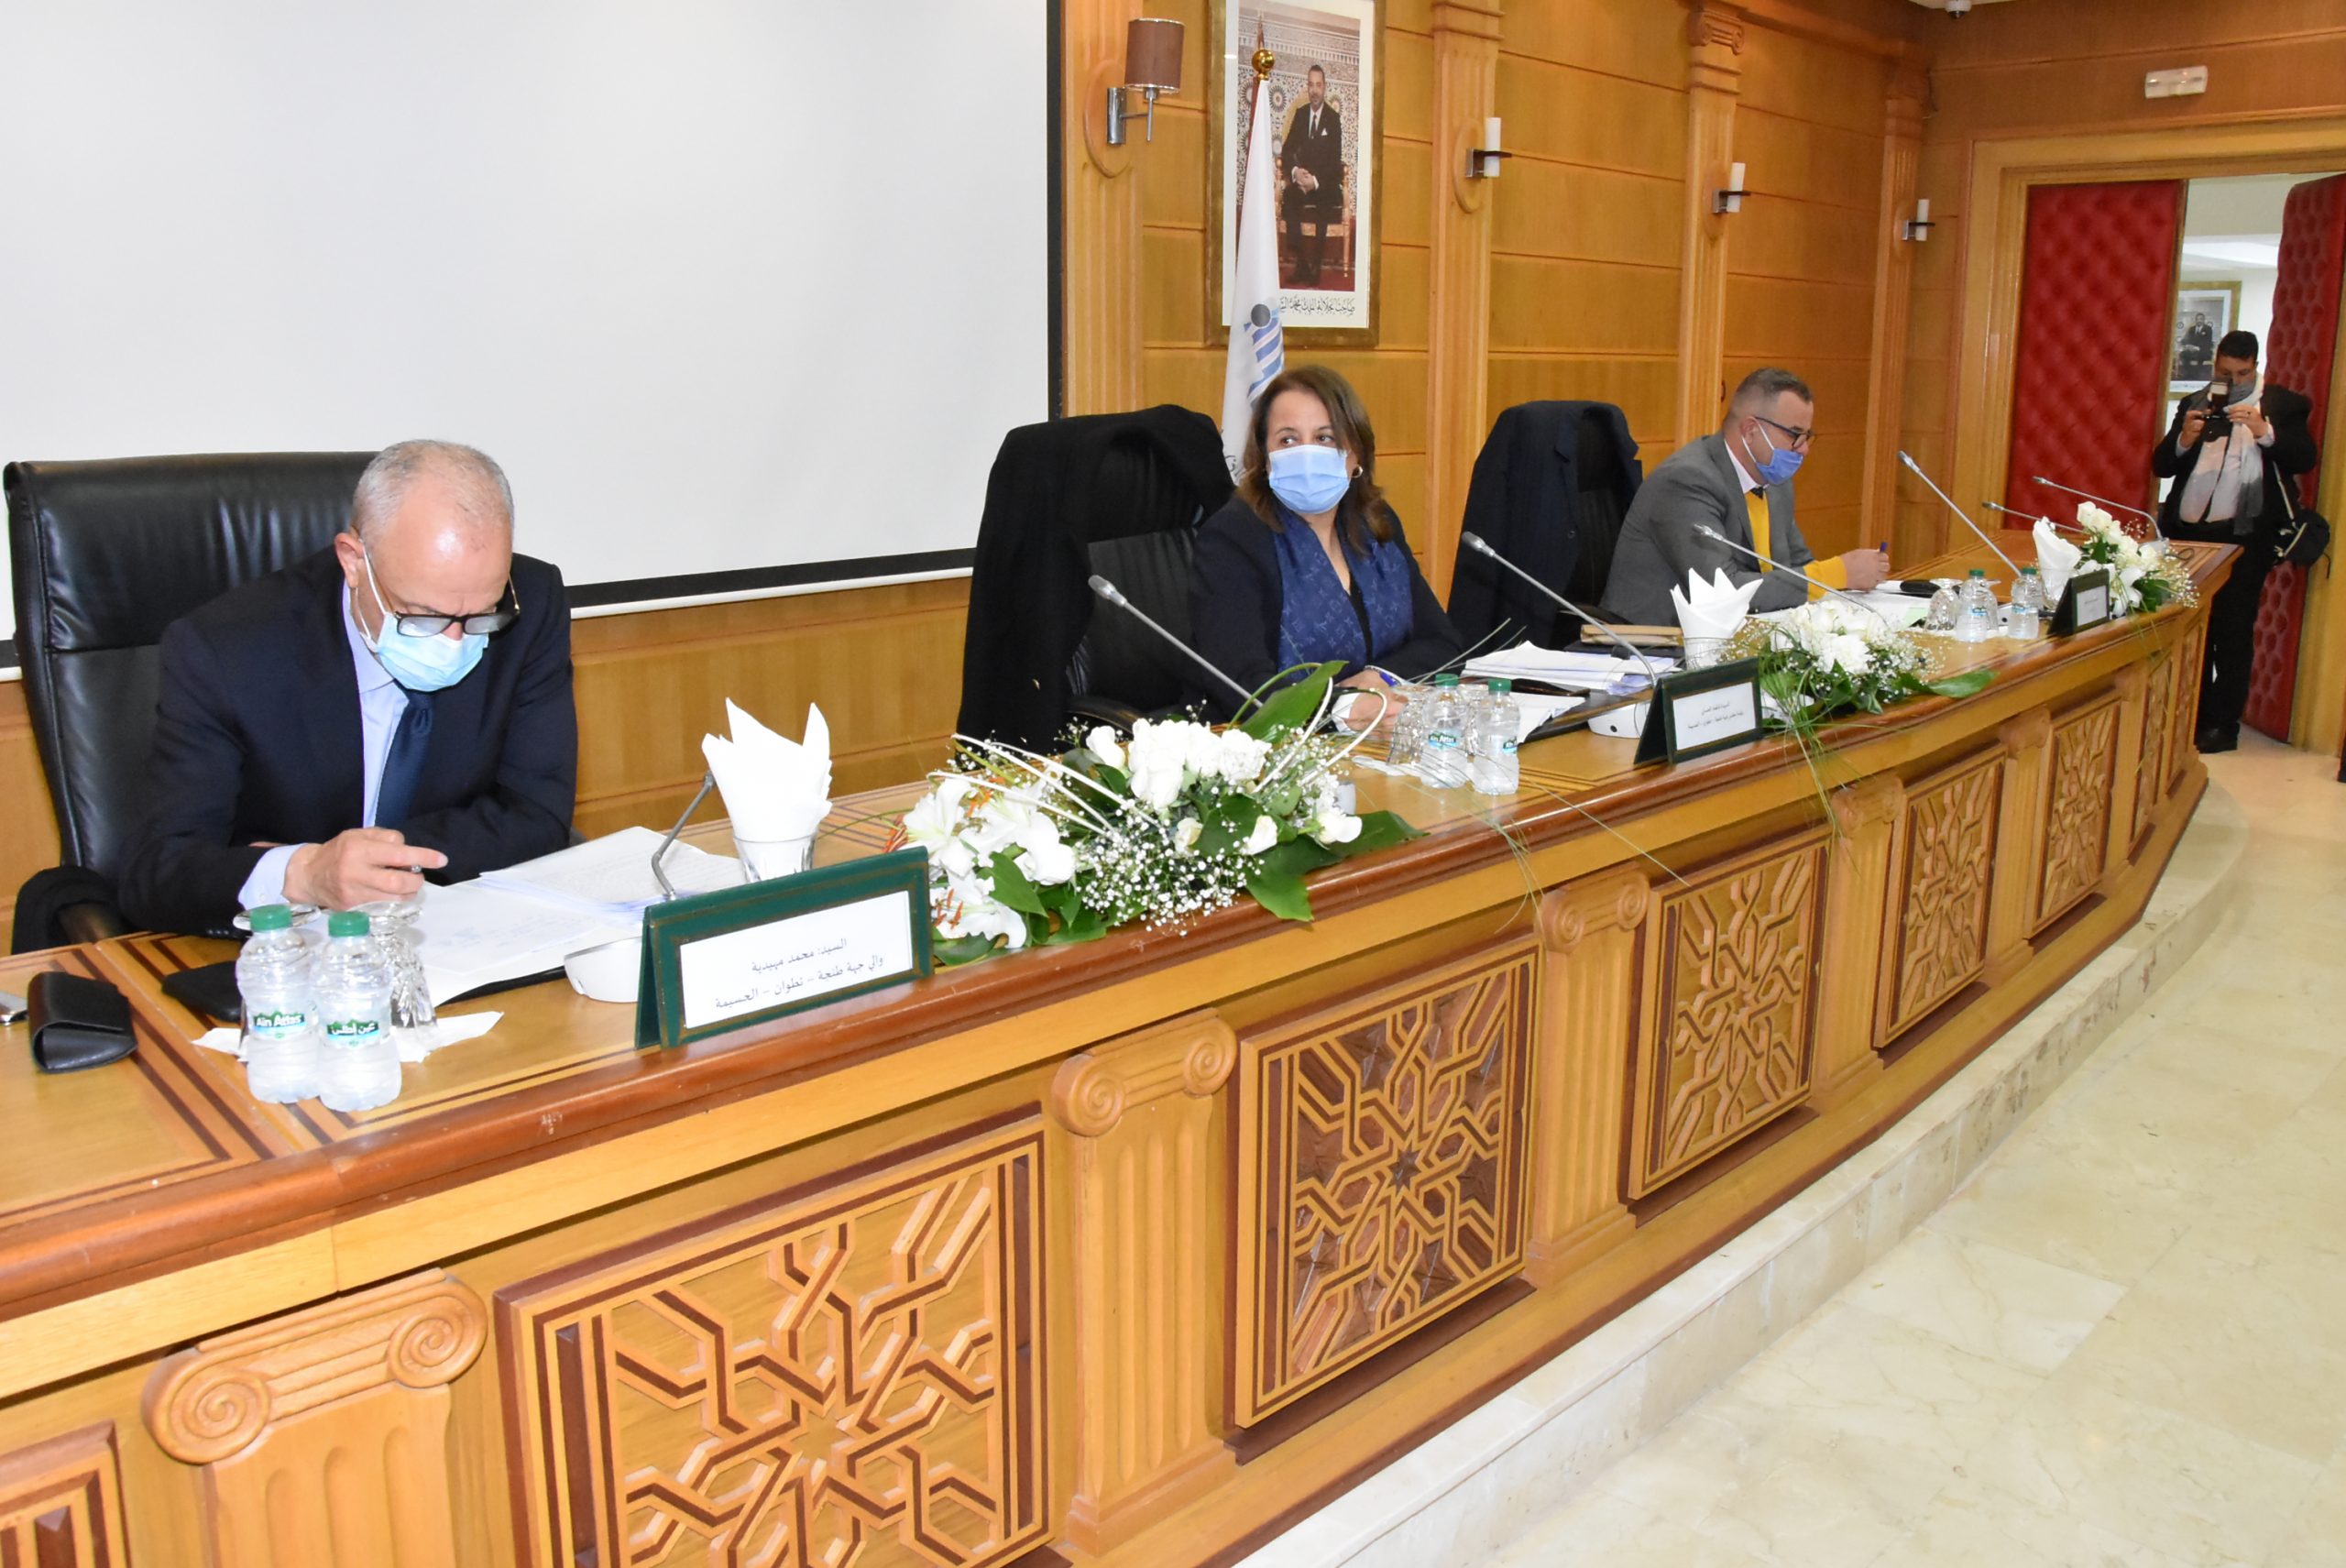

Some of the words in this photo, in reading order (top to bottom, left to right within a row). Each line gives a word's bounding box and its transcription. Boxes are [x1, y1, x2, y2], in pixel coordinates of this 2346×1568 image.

[788, 951, 814, 964] محمد
[818, 968, 843, 981] طنجة
[847, 962, 863, 974] جهة
[774, 977, 804, 996] تطوان
[715, 989, 758, 1008] الحسيمة
